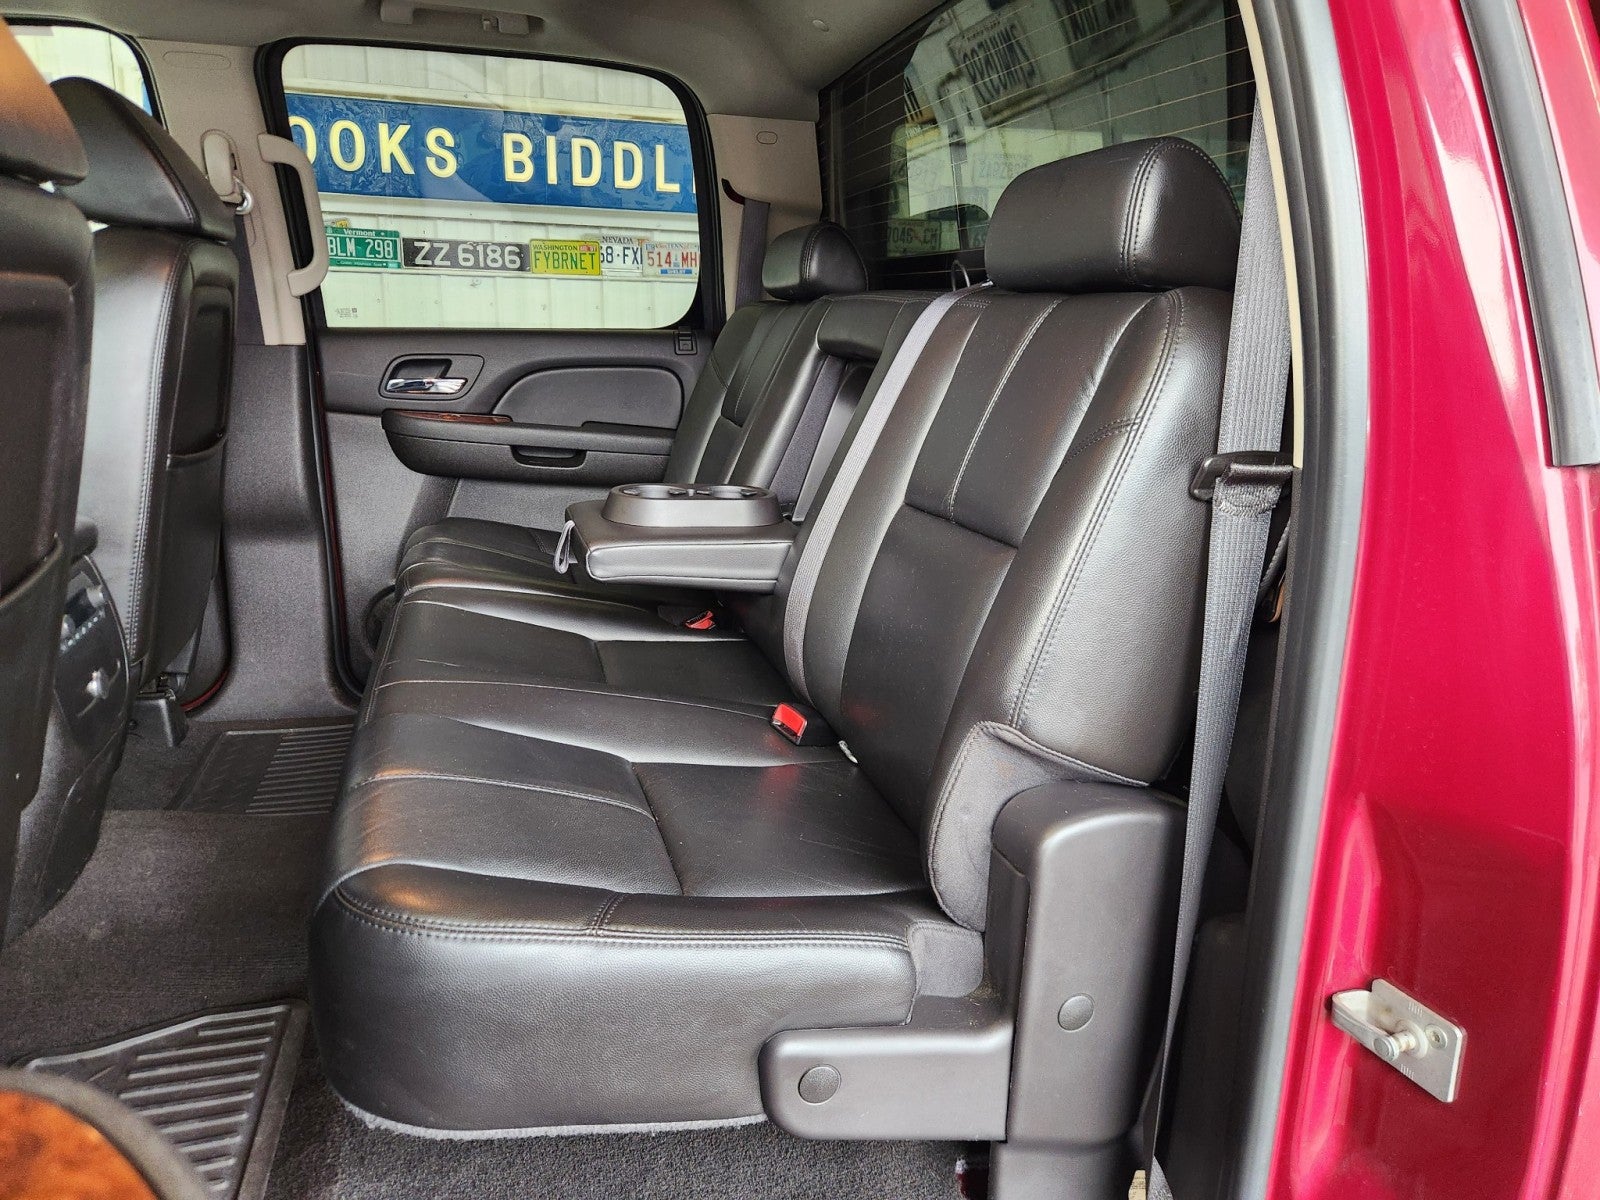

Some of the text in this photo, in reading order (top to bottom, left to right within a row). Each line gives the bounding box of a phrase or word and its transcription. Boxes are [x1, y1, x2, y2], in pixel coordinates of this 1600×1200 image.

[503, 132, 697, 194] BIDDL
[343, 228, 376, 238] Vermont
[601, 235, 634, 246] NEVADA
[327, 236, 393, 259] BLM 298
[413, 241, 521, 269] ZZ 6186
[533, 250, 596, 270] FYBRNET
[647, 251, 672, 268] 514
